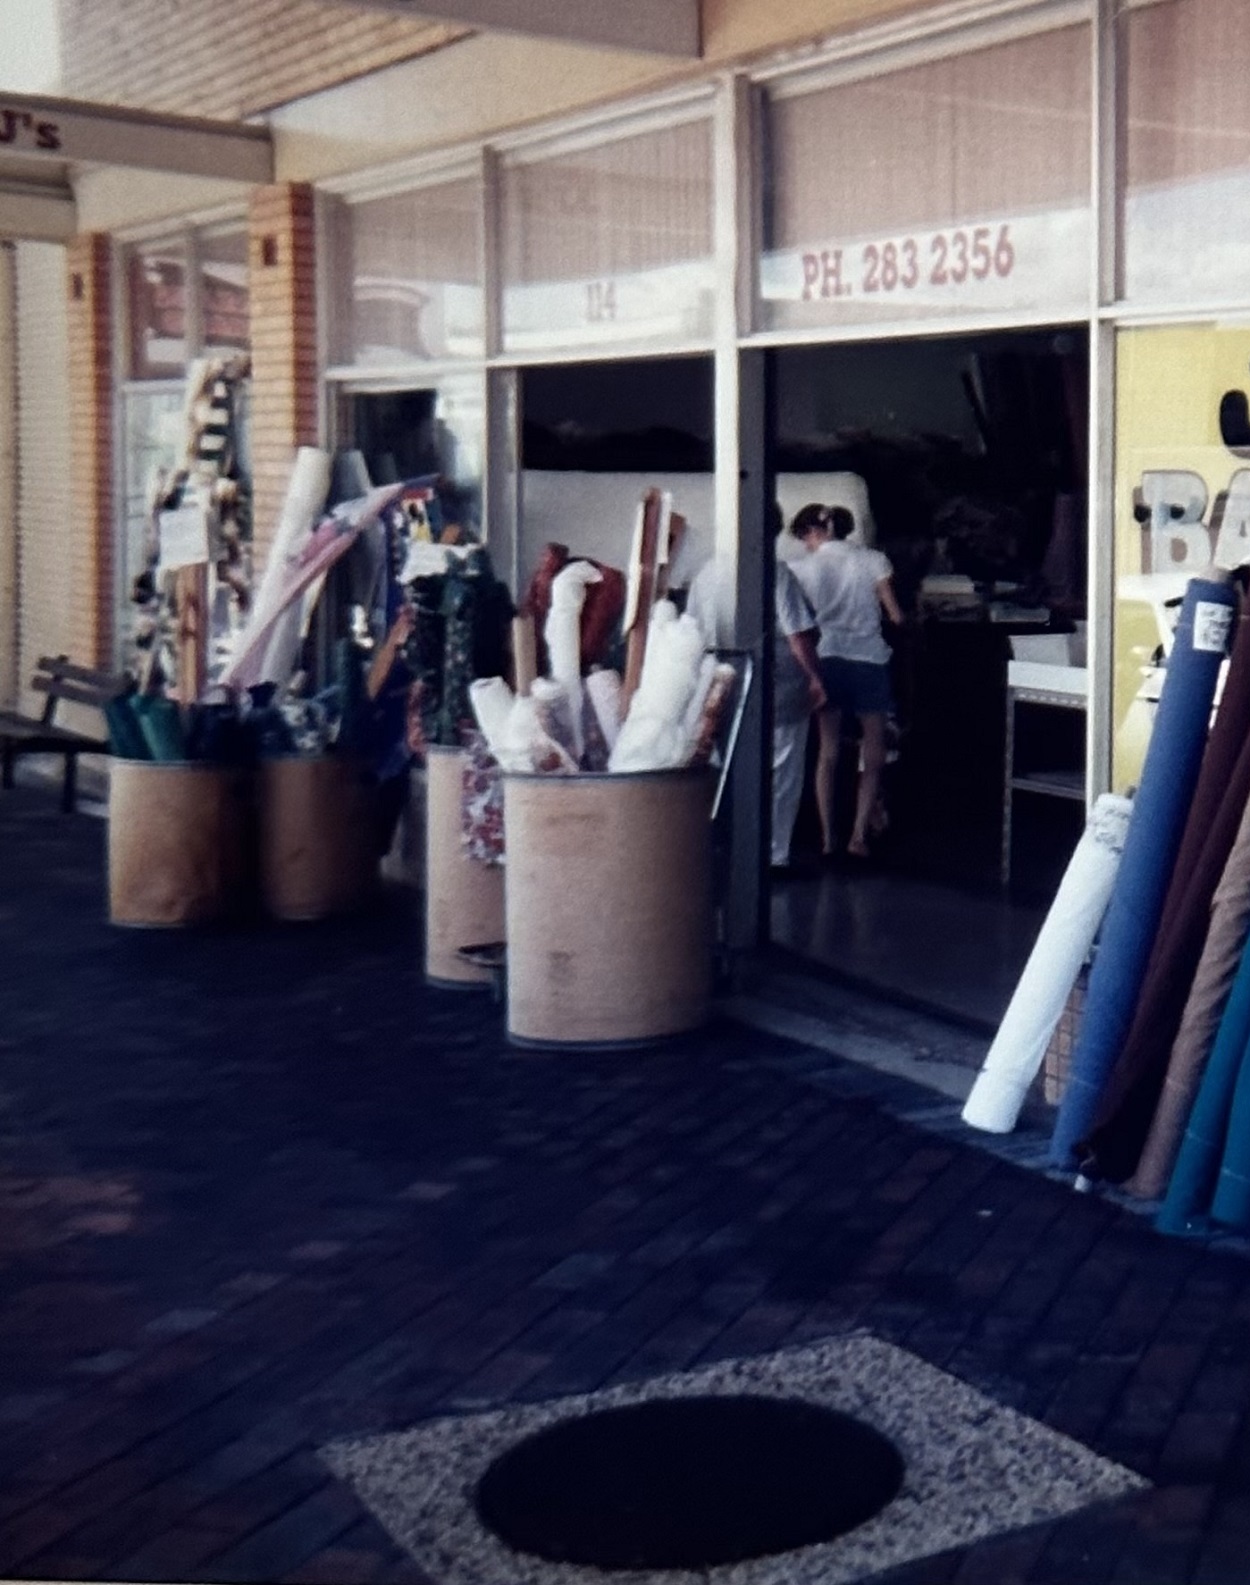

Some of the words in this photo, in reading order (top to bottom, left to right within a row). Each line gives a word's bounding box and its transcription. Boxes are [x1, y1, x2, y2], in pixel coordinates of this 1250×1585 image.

[802, 250, 852, 300] PH.
[862, 238, 919, 293] 283
[930, 224, 1015, 285] 2356
